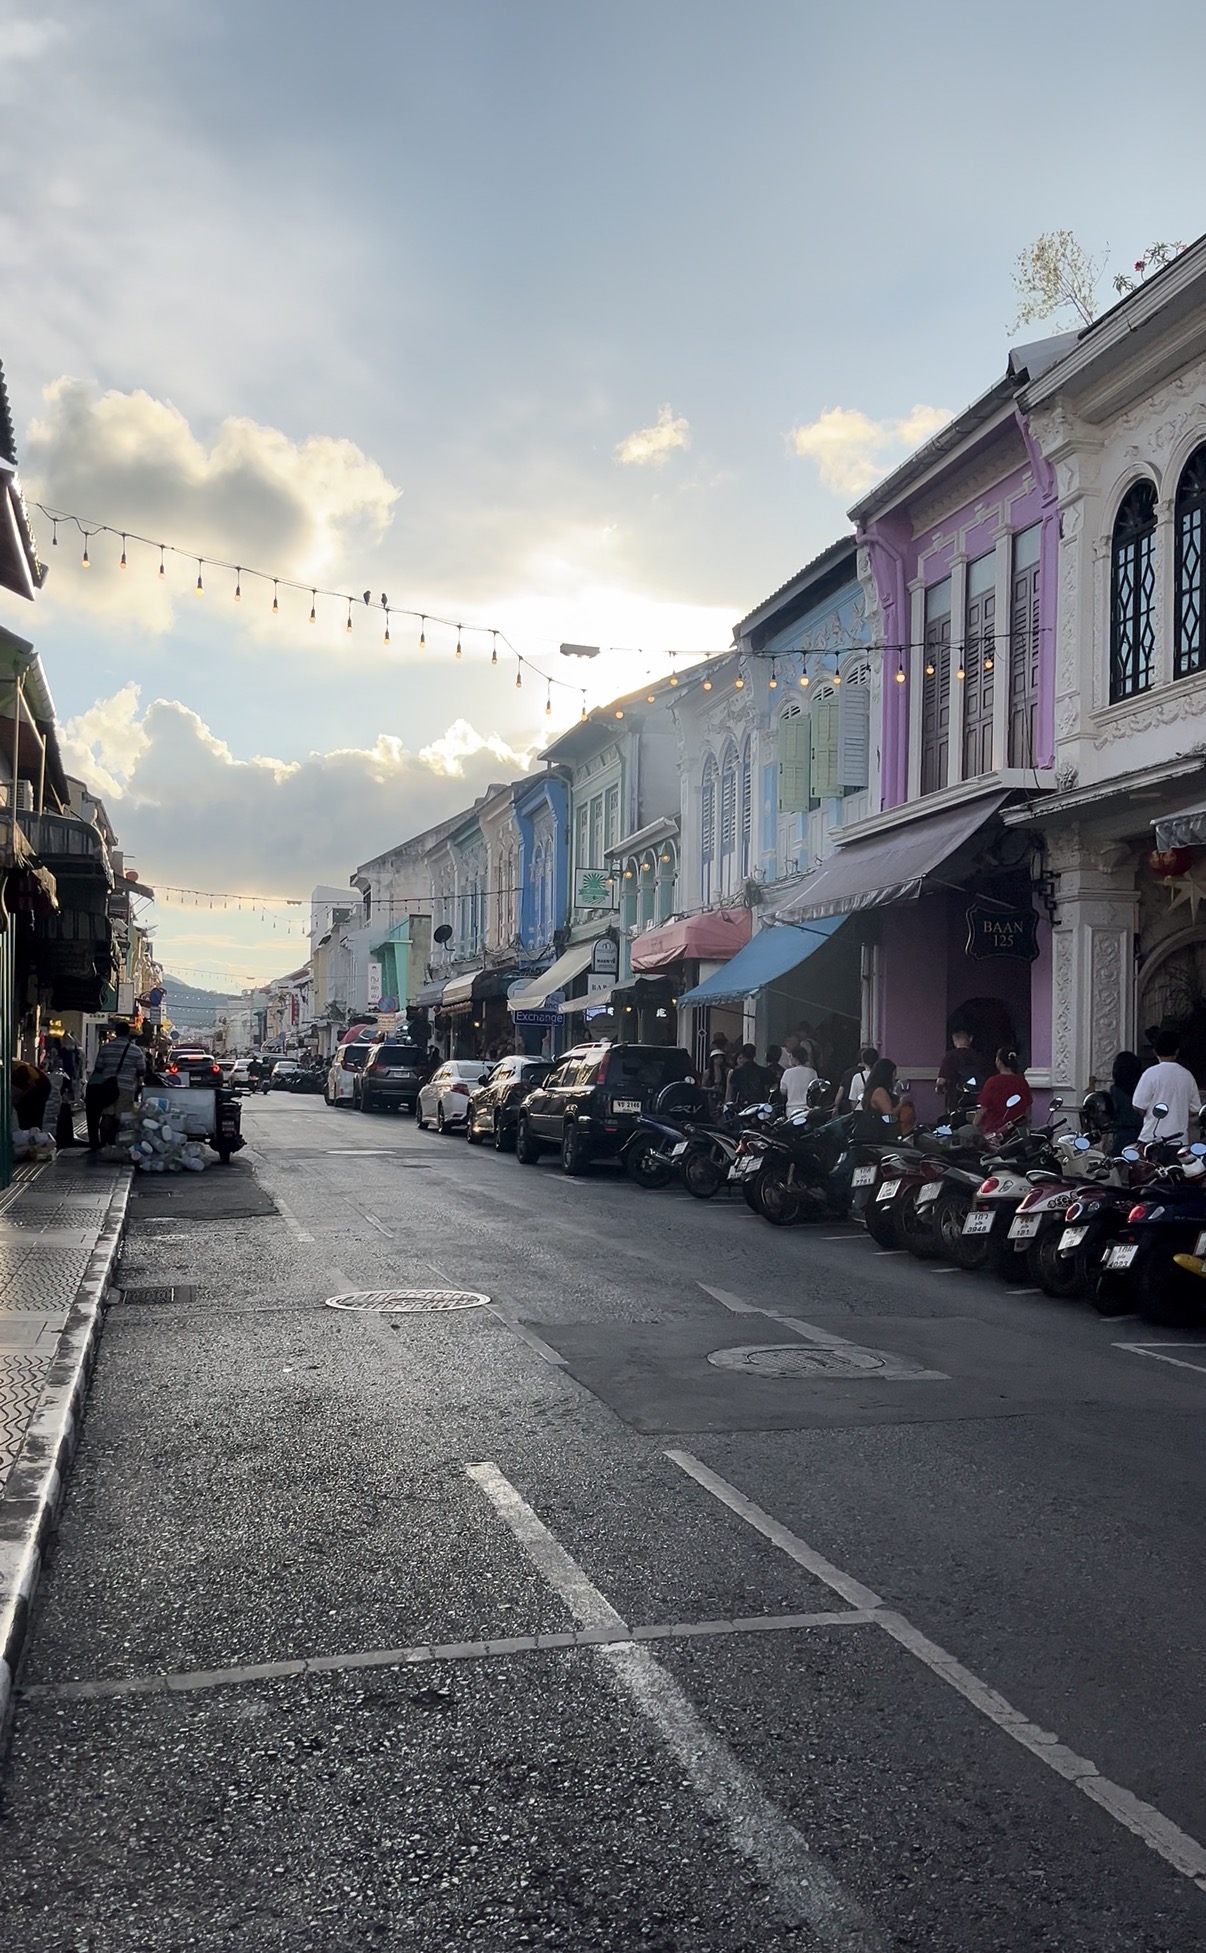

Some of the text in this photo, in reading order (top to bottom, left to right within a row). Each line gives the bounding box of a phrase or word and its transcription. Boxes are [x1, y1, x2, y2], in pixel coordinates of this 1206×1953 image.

[983, 920, 1024, 933] BAAN
[994, 934, 1014, 947] 125
[516, 1011, 563, 1025] Exchange
